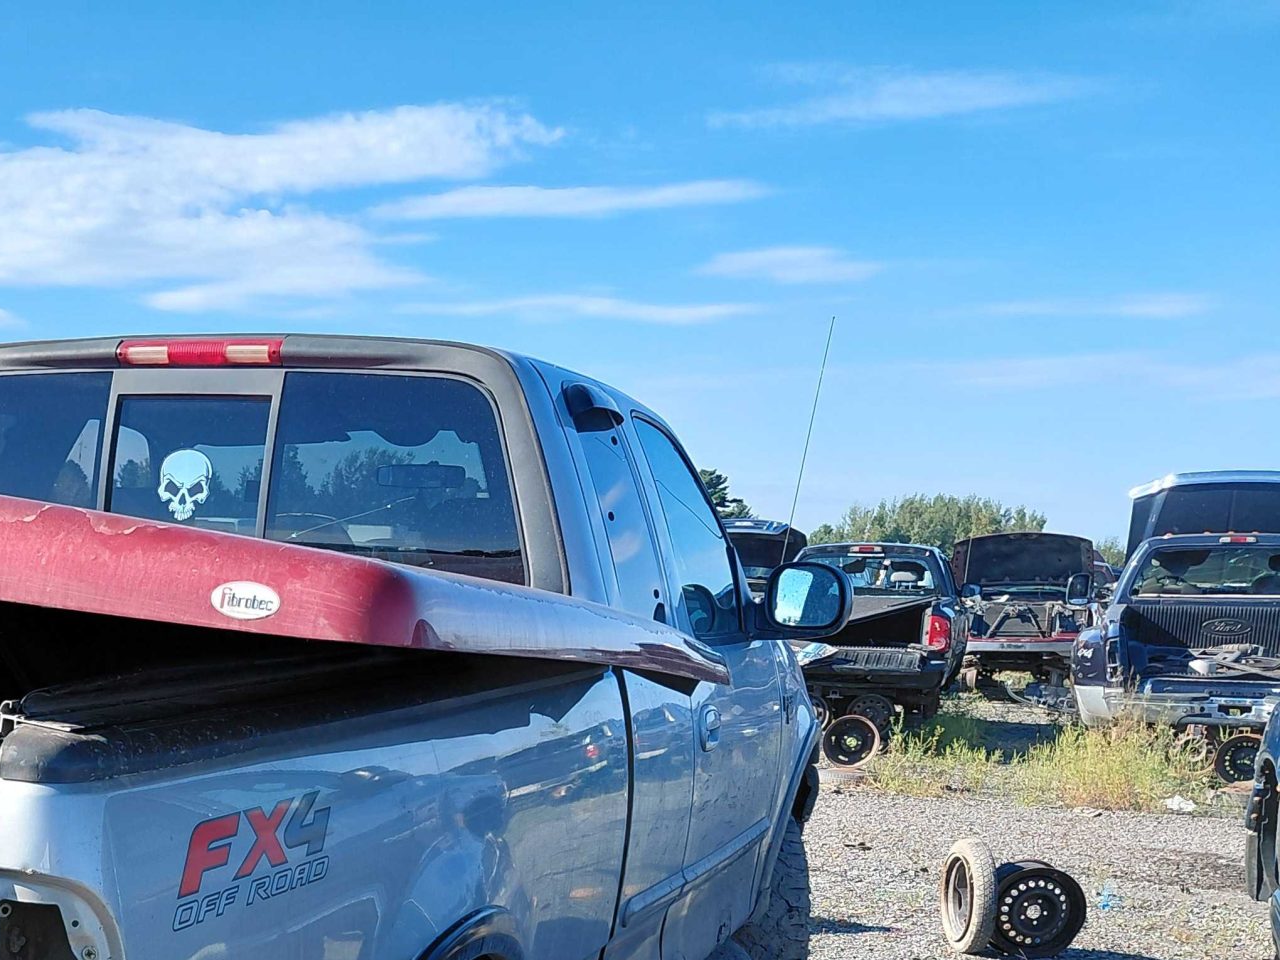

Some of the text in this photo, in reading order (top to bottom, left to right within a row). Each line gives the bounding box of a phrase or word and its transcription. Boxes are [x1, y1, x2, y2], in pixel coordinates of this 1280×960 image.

[177, 789, 332, 900] FX4
[172, 855, 330, 932] OFF ROAD
